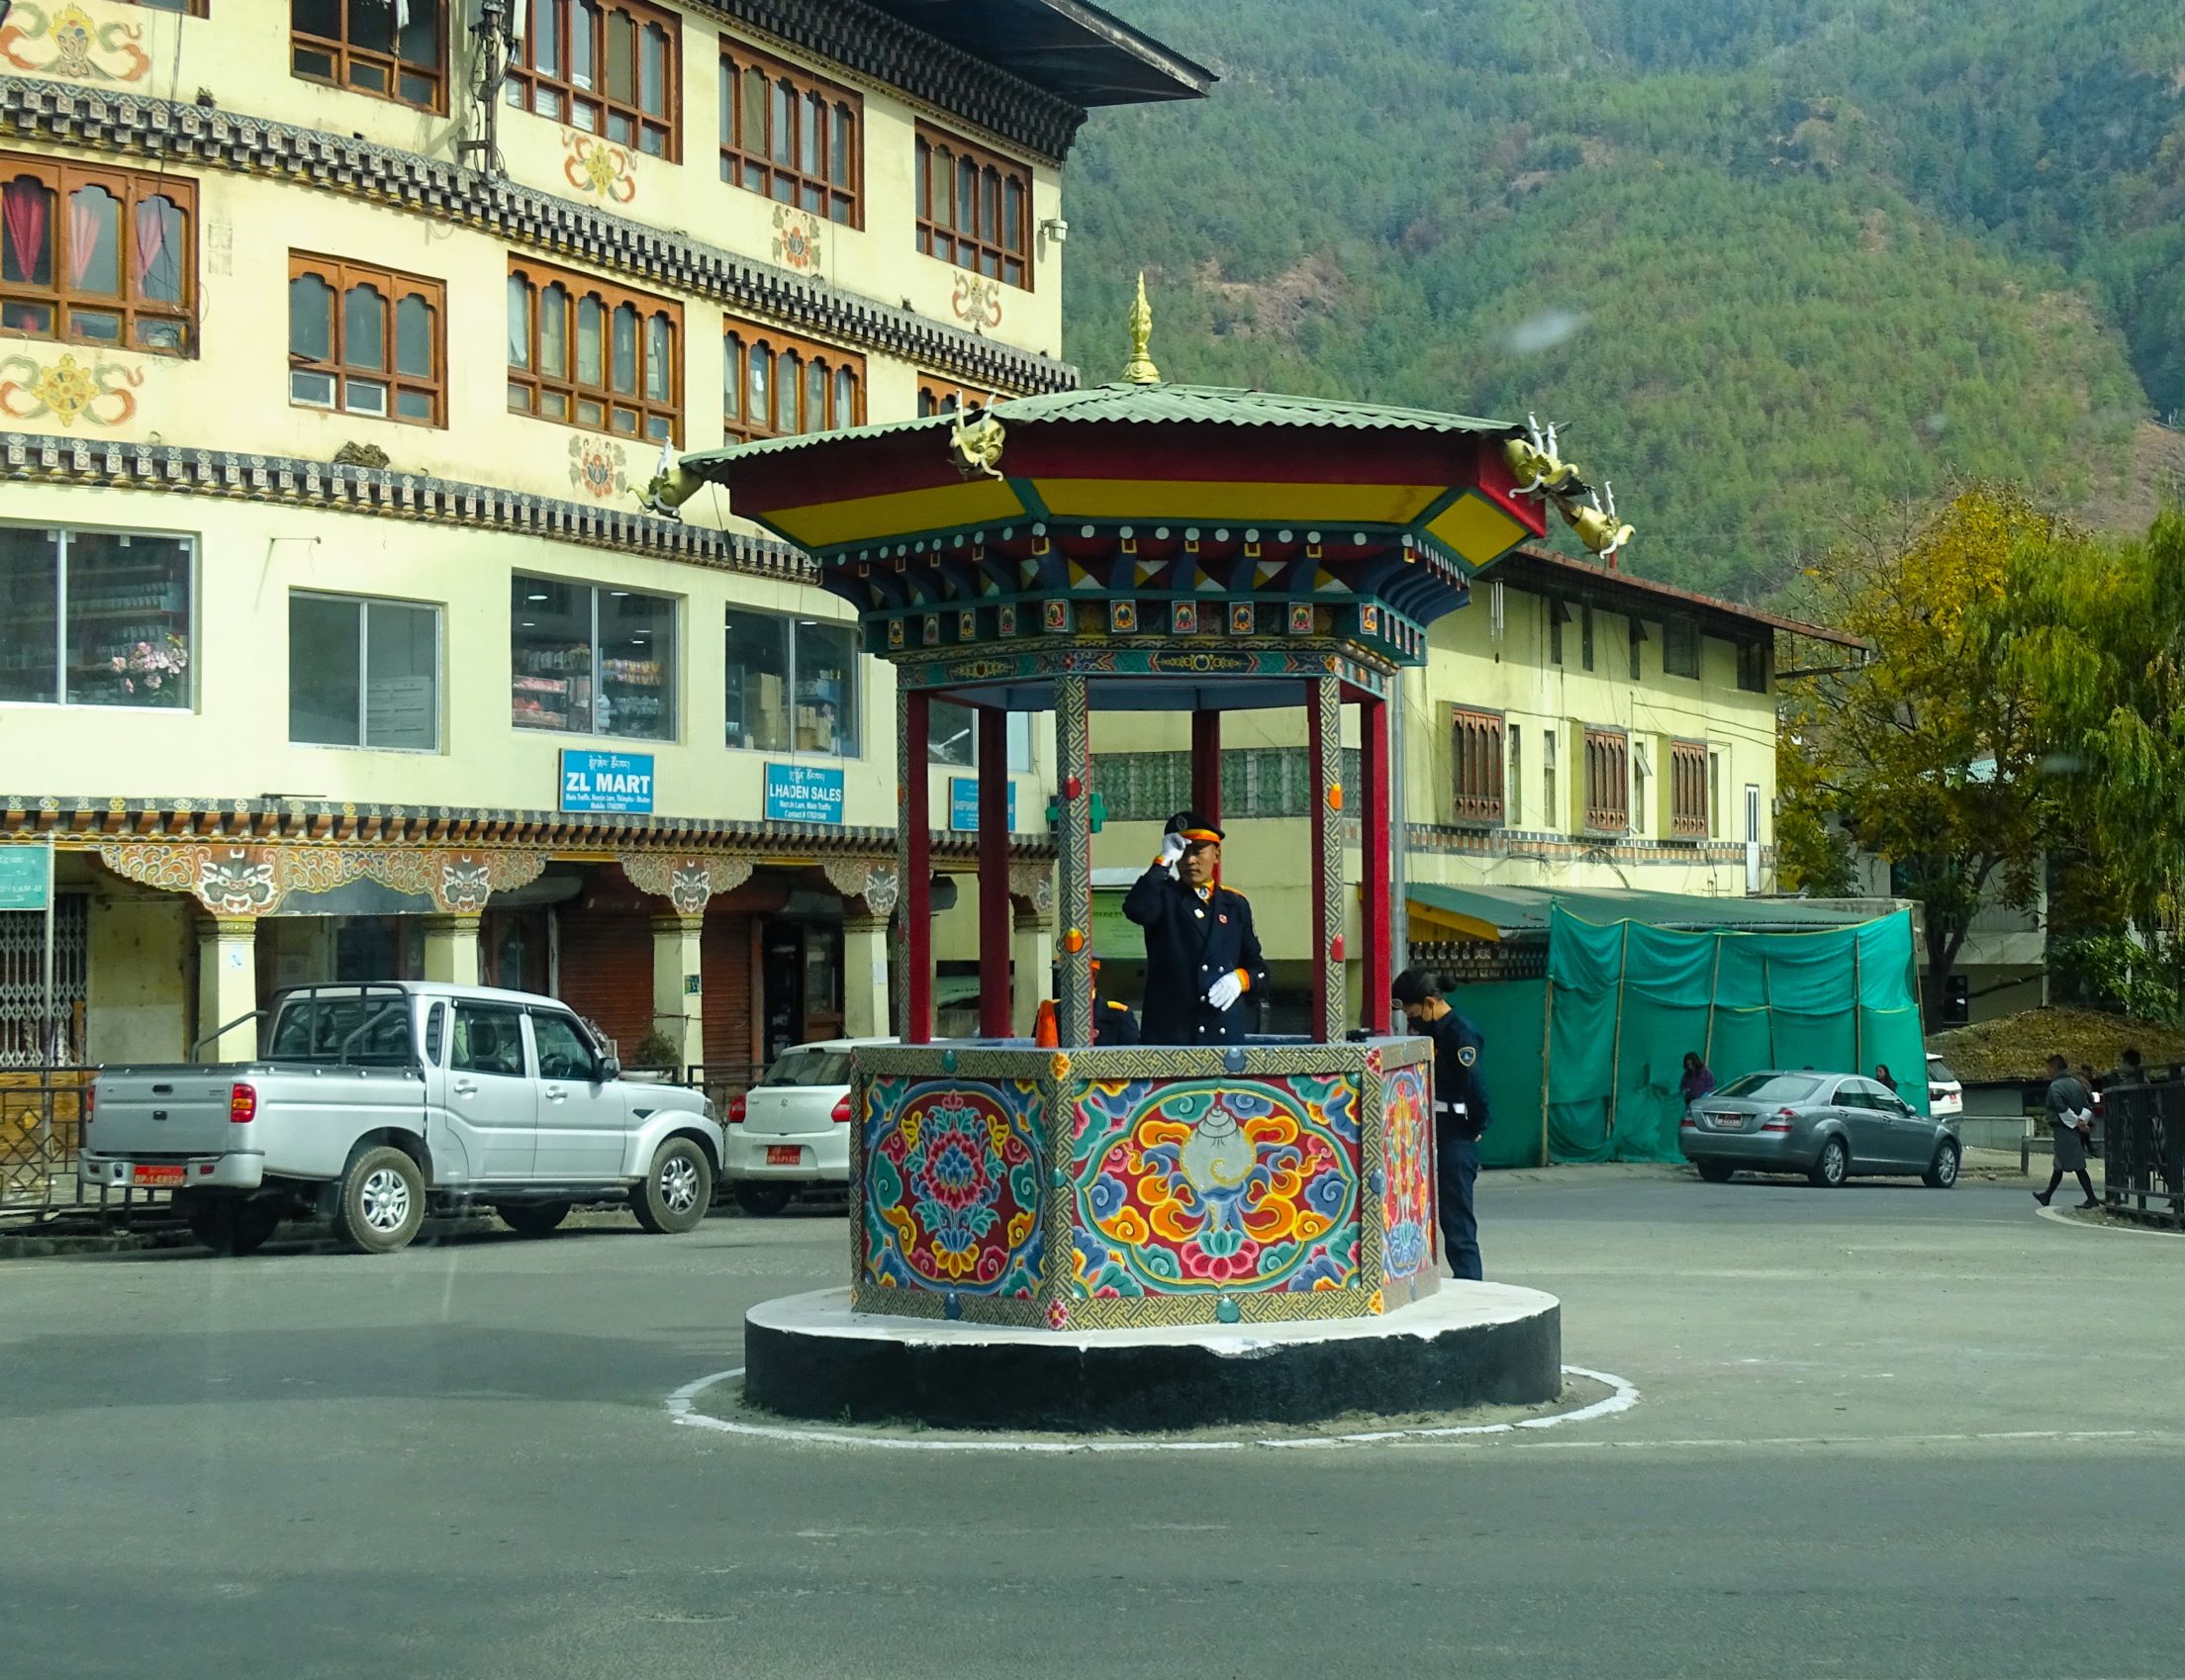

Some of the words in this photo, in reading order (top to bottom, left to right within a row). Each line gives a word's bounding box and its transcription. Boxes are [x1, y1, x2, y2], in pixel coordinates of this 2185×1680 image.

[565, 772, 591, 792] ZL
[596, 773, 650, 794] MART
[770, 784, 808, 798] LHADEN
[811, 787, 841, 801] SALES
